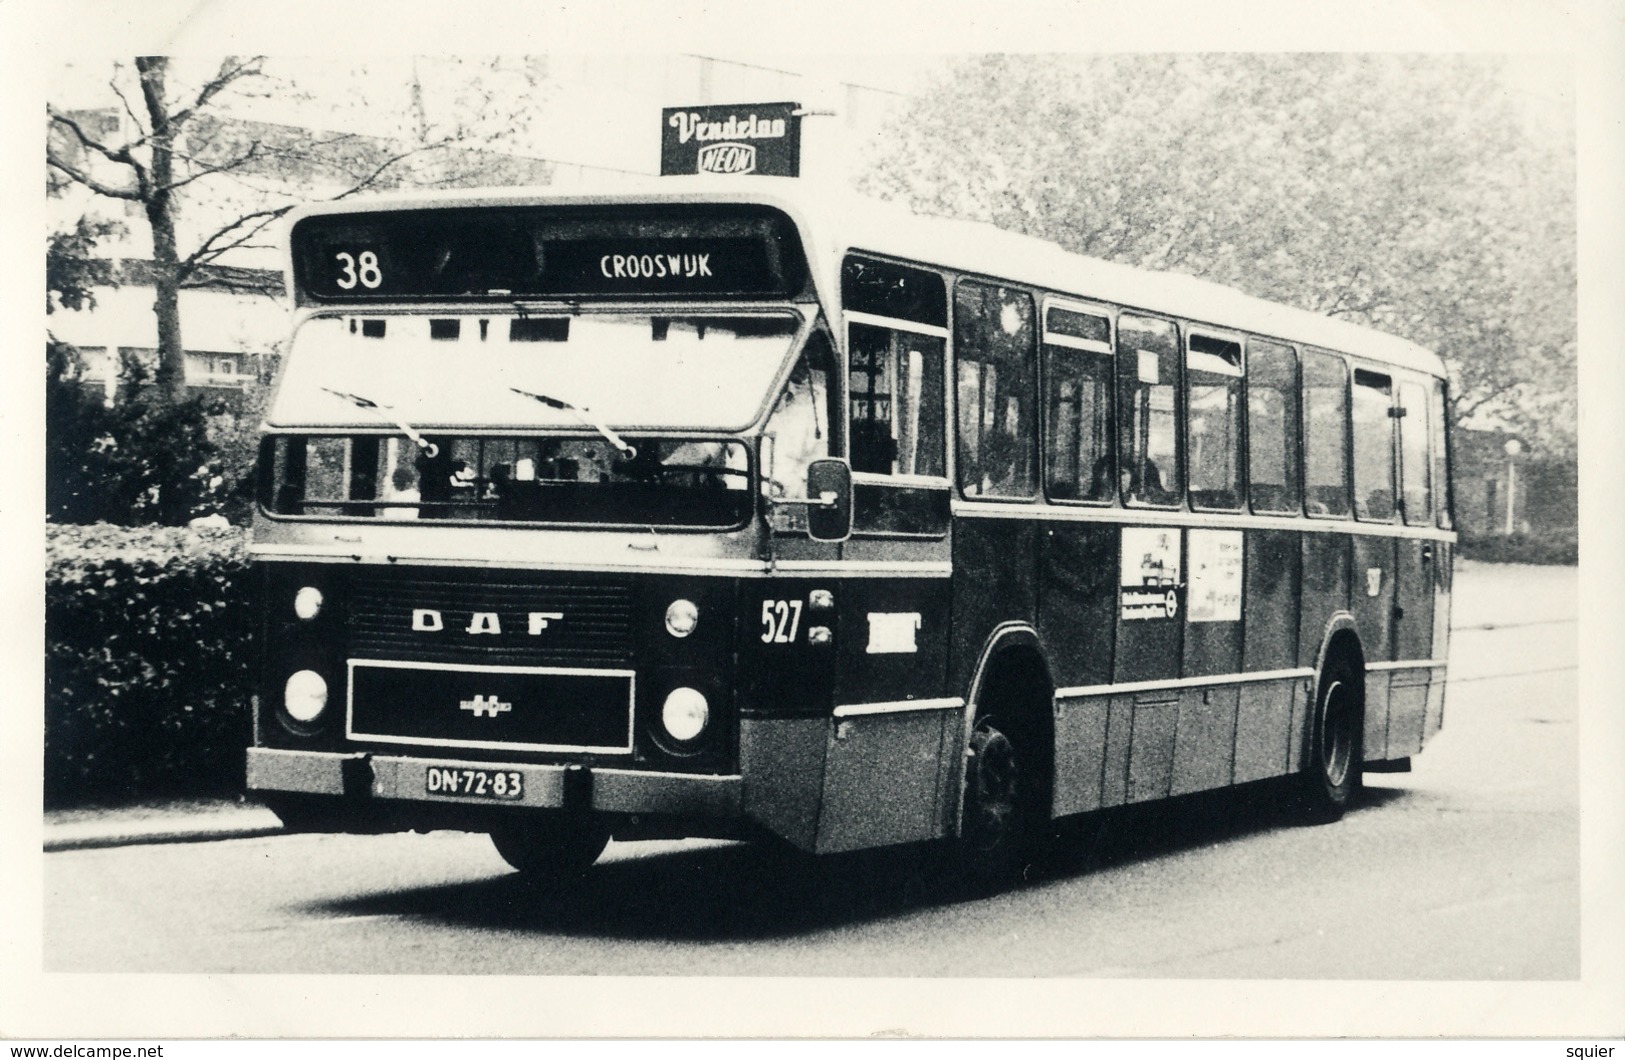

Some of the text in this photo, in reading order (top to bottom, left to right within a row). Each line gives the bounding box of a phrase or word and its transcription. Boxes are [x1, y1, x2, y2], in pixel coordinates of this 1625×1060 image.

[702, 147, 751, 173] NEON
[336, 251, 382, 289] 38
[600, 253, 713, 279] CROOSWIJK
[412, 609, 563, 635] DAF
[761, 600, 803, 643] 527
